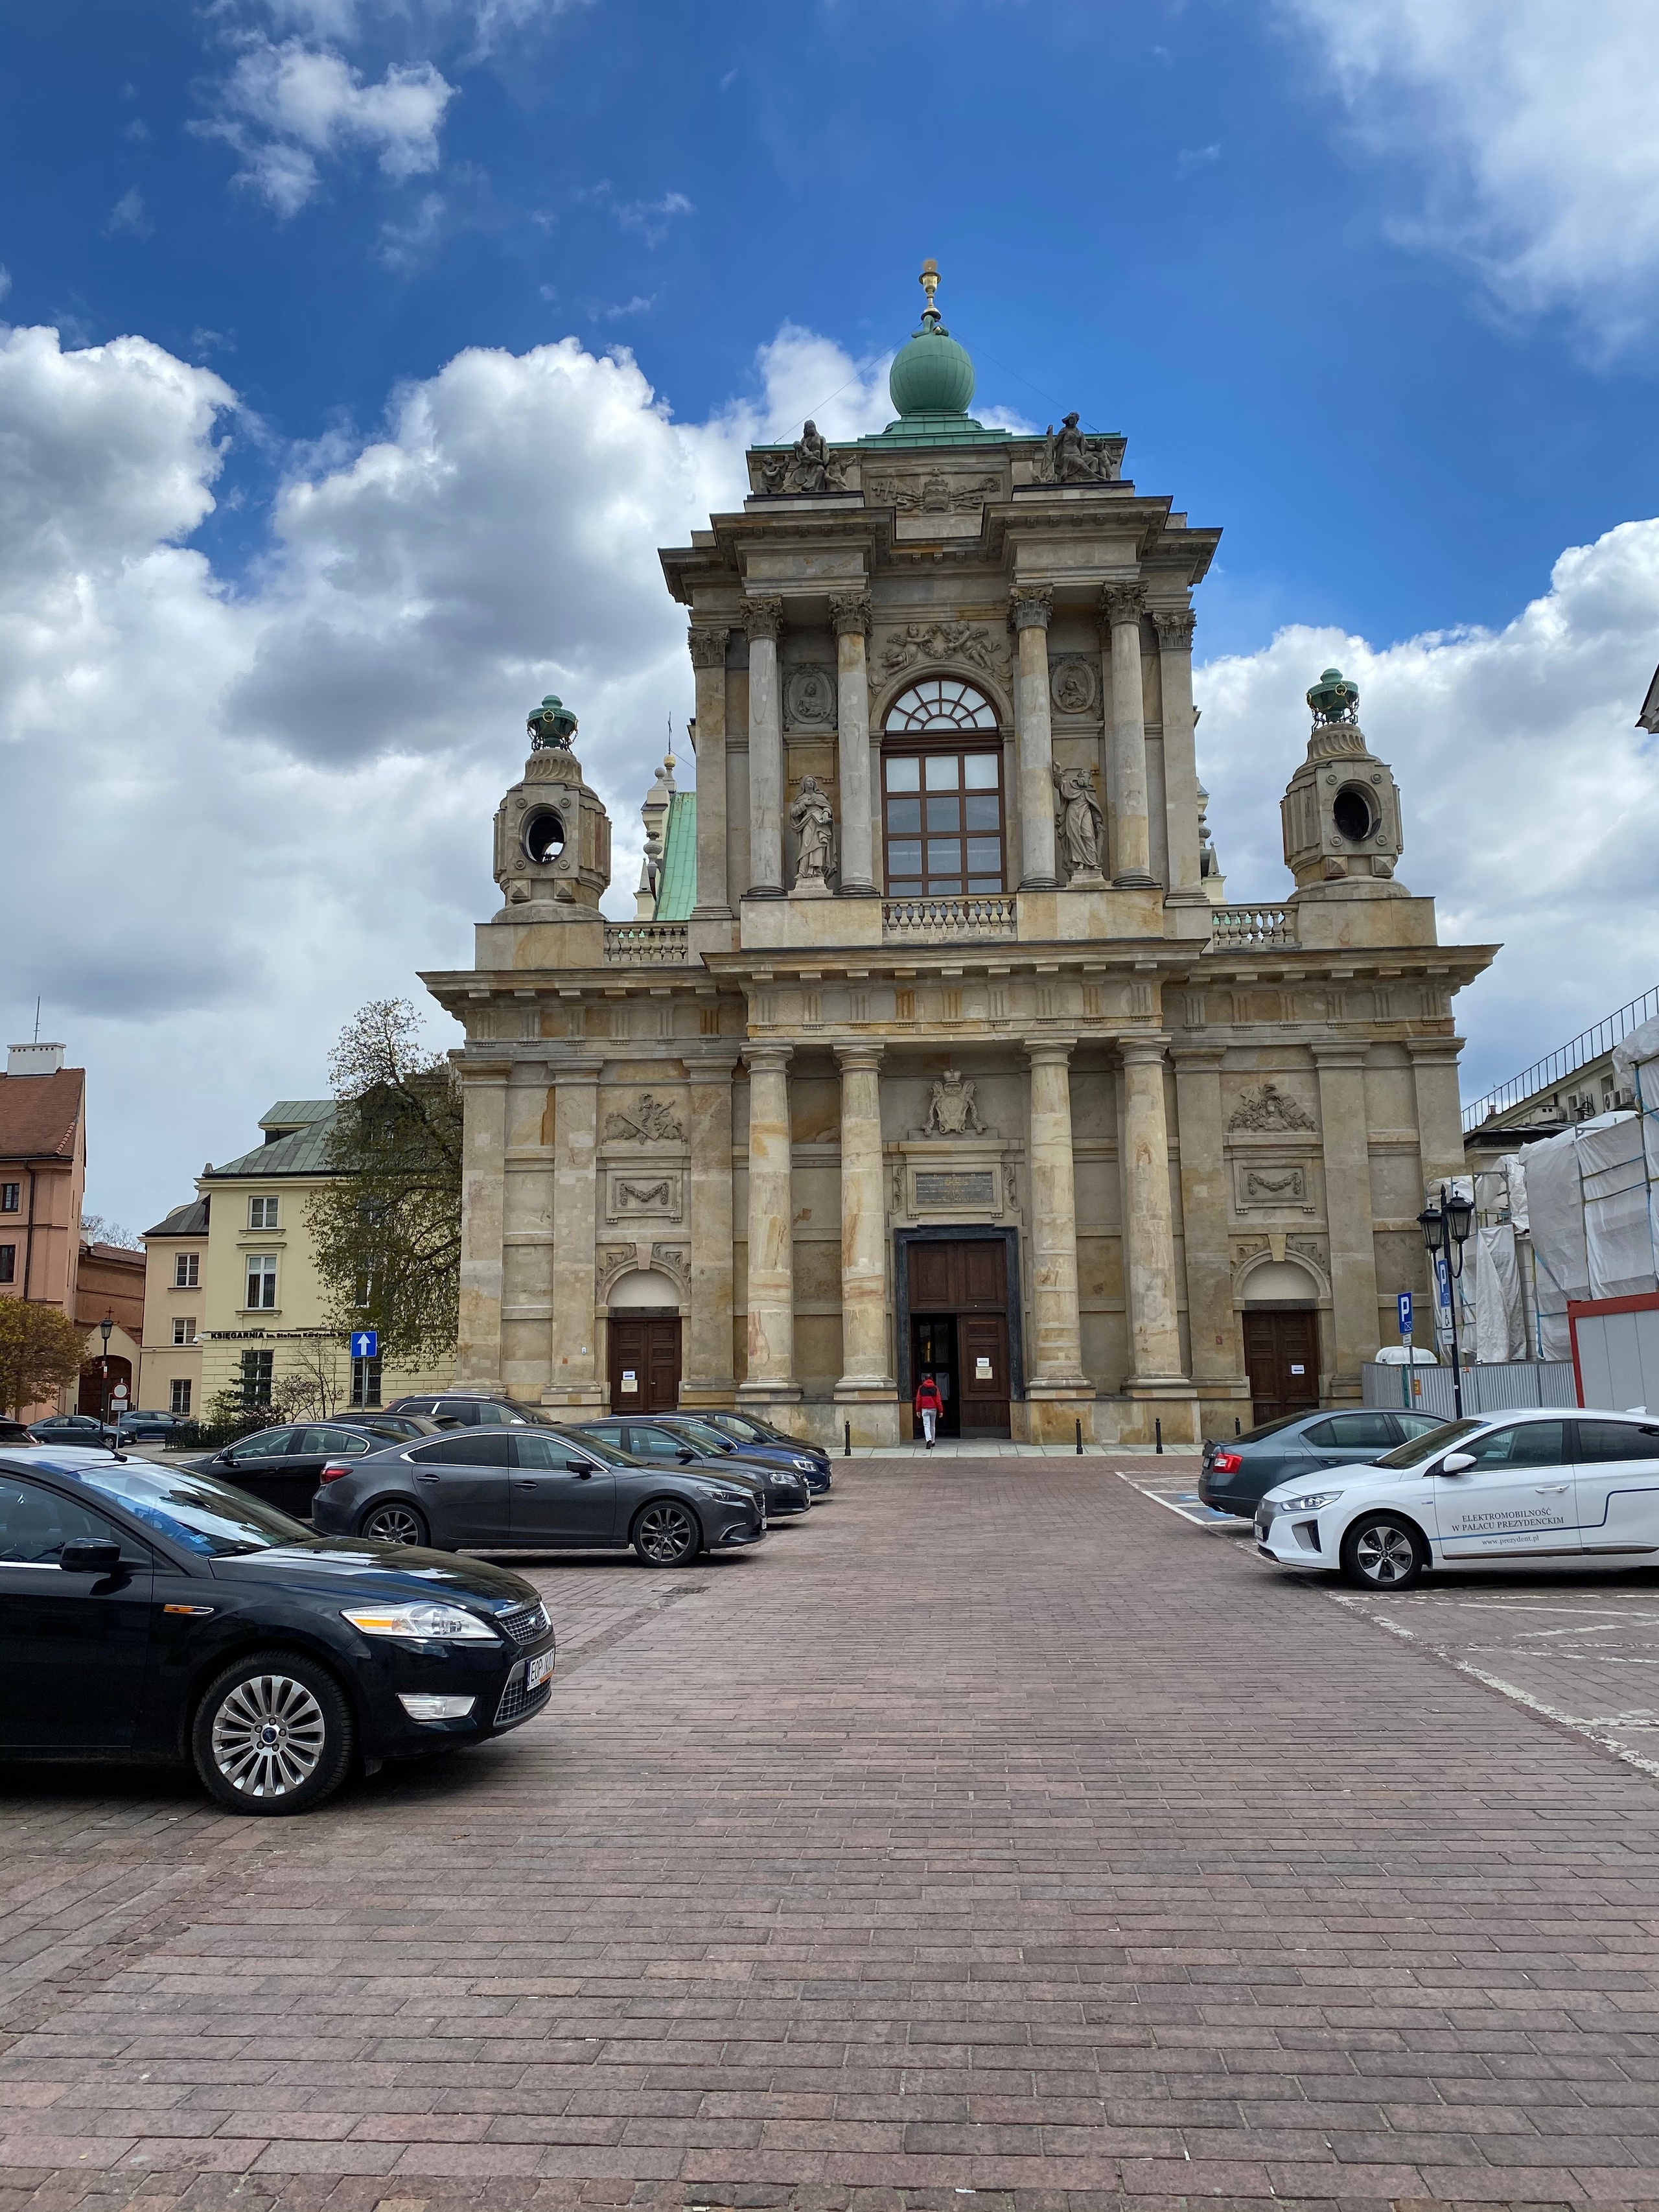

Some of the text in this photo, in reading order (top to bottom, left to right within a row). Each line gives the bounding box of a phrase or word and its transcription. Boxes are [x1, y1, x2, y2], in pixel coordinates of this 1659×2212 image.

[1439, 1264, 1447, 1293] P
[1400, 1296, 1410, 1322] P
[1461, 1508, 1552, 1522] ELEKTROMOBILNOŚĆ
[1461, 1522, 1495, 1531] PAŁACU
[1497, 1516, 1564, 1530] PREZYDENCKIM
[1481, 1534, 1540, 1546] www.prezydent.pl
